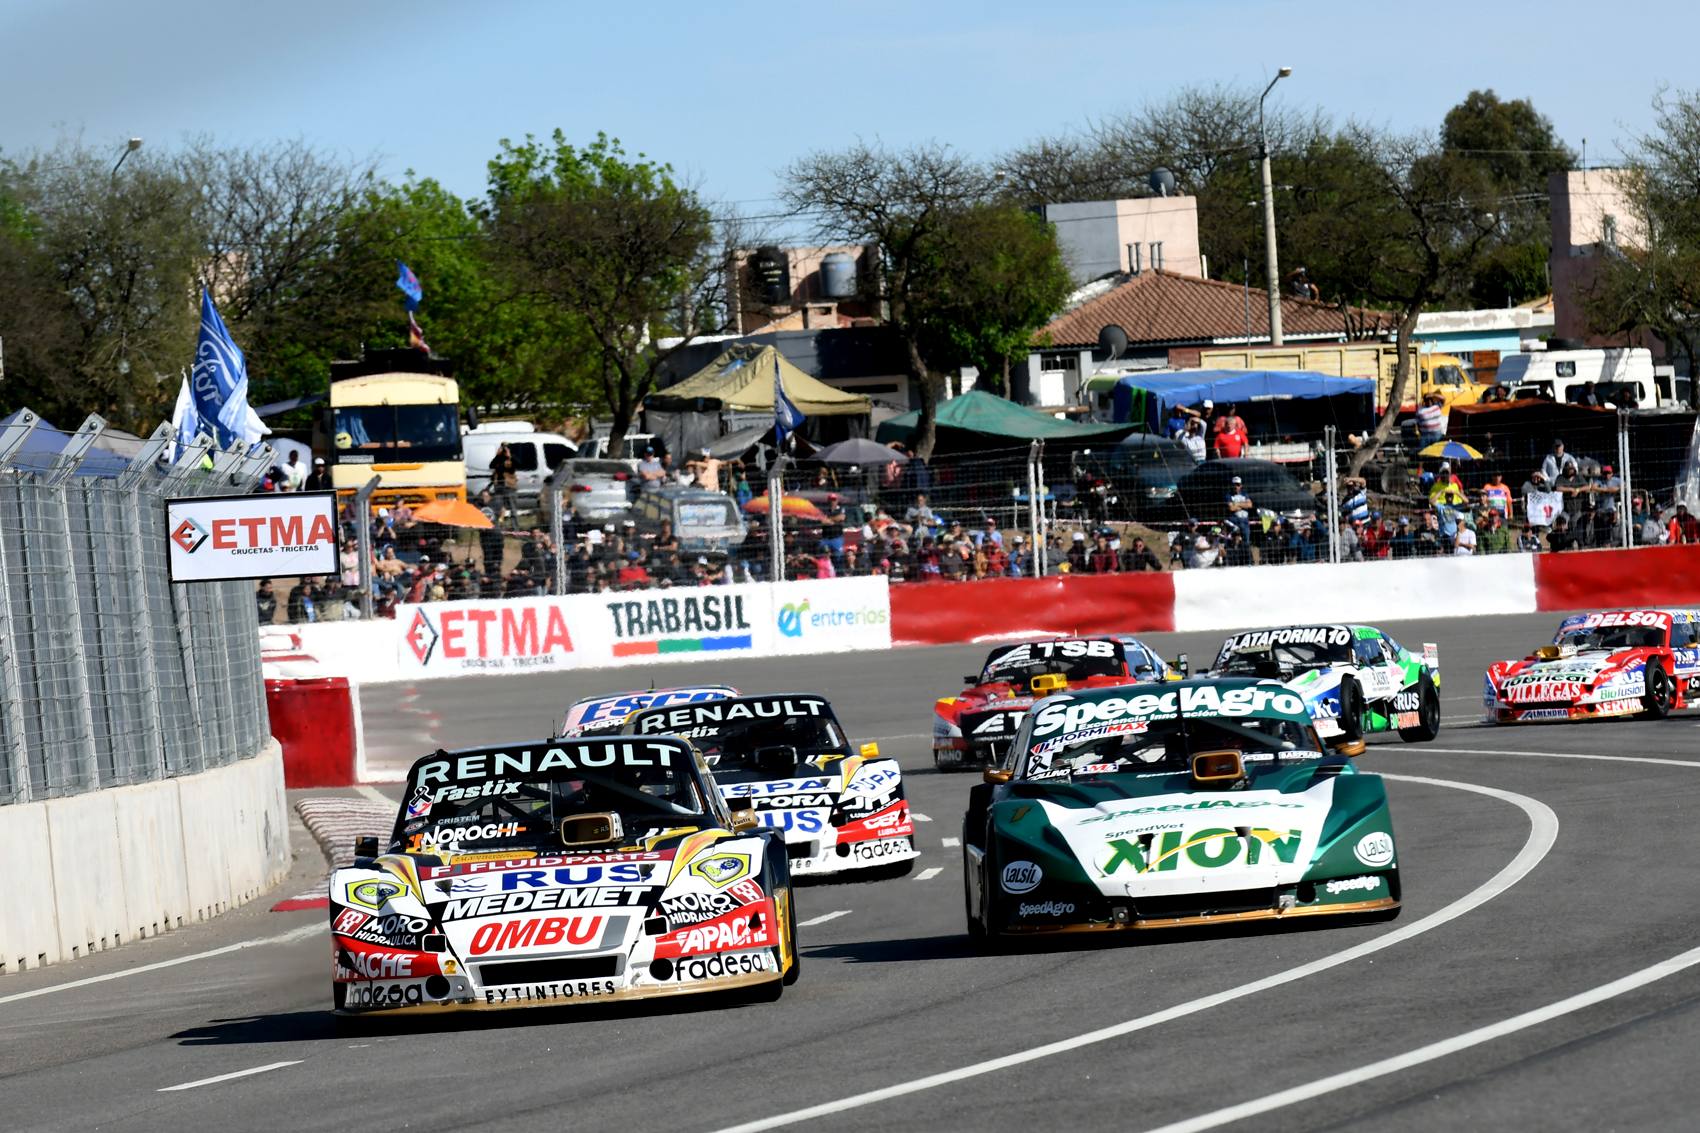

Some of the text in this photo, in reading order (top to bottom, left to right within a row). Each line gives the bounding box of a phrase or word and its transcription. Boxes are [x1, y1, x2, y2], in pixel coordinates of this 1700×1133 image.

[212, 514, 335, 549] ETMA
[231, 547, 274, 555] CRUCETAS
[281, 544, 319, 553] TRICETAS
[607, 595, 751, 638] TRABASIL
[1584, 612, 1667, 630] DELSOL
[440, 605, 575, 658] ETMA
[1222, 628, 1326, 652] PLATAFORMA
[1328, 629, 1350, 646] 10
[1397, 692, 1420, 711] RUS
[1507, 682, 1582, 702] VILLEGAS
[641, 701, 824, 734] RENAULT
[1033, 685, 1305, 736] SpeedAgro
[1079, 710, 1218, 729] Excelencia Innoación
[584, 718, 625, 732] Kapp
[1051, 721, 1146, 745] HORMIMAX
[417, 743, 682, 789] RENAULT
[434, 779, 522, 804] Fastix
[757, 810, 823, 834] US
[1077, 800, 1305, 825] SpeedAgro
[1105, 823, 1184, 839] SpeedWet
[470, 851, 660, 872] FLUIDPARTS
[1101, 828, 1302, 875] XION
[502, 864, 653, 891] RUS
[442, 886, 653, 921] MEDEMET
[663, 892, 731, 914] MORO
[669, 903, 739, 925] HIDRAULICA
[1019, 901, 1075, 918] SpeedAgro
[363, 915, 429, 935] MORO
[469, 915, 603, 955] OMBU
[354, 929, 417, 946] HIDRAULICA
[443, 960, 457, 974] 2
[675, 952, 766, 981] fadesa
[484, 980, 616, 1004] EXTINTORES
